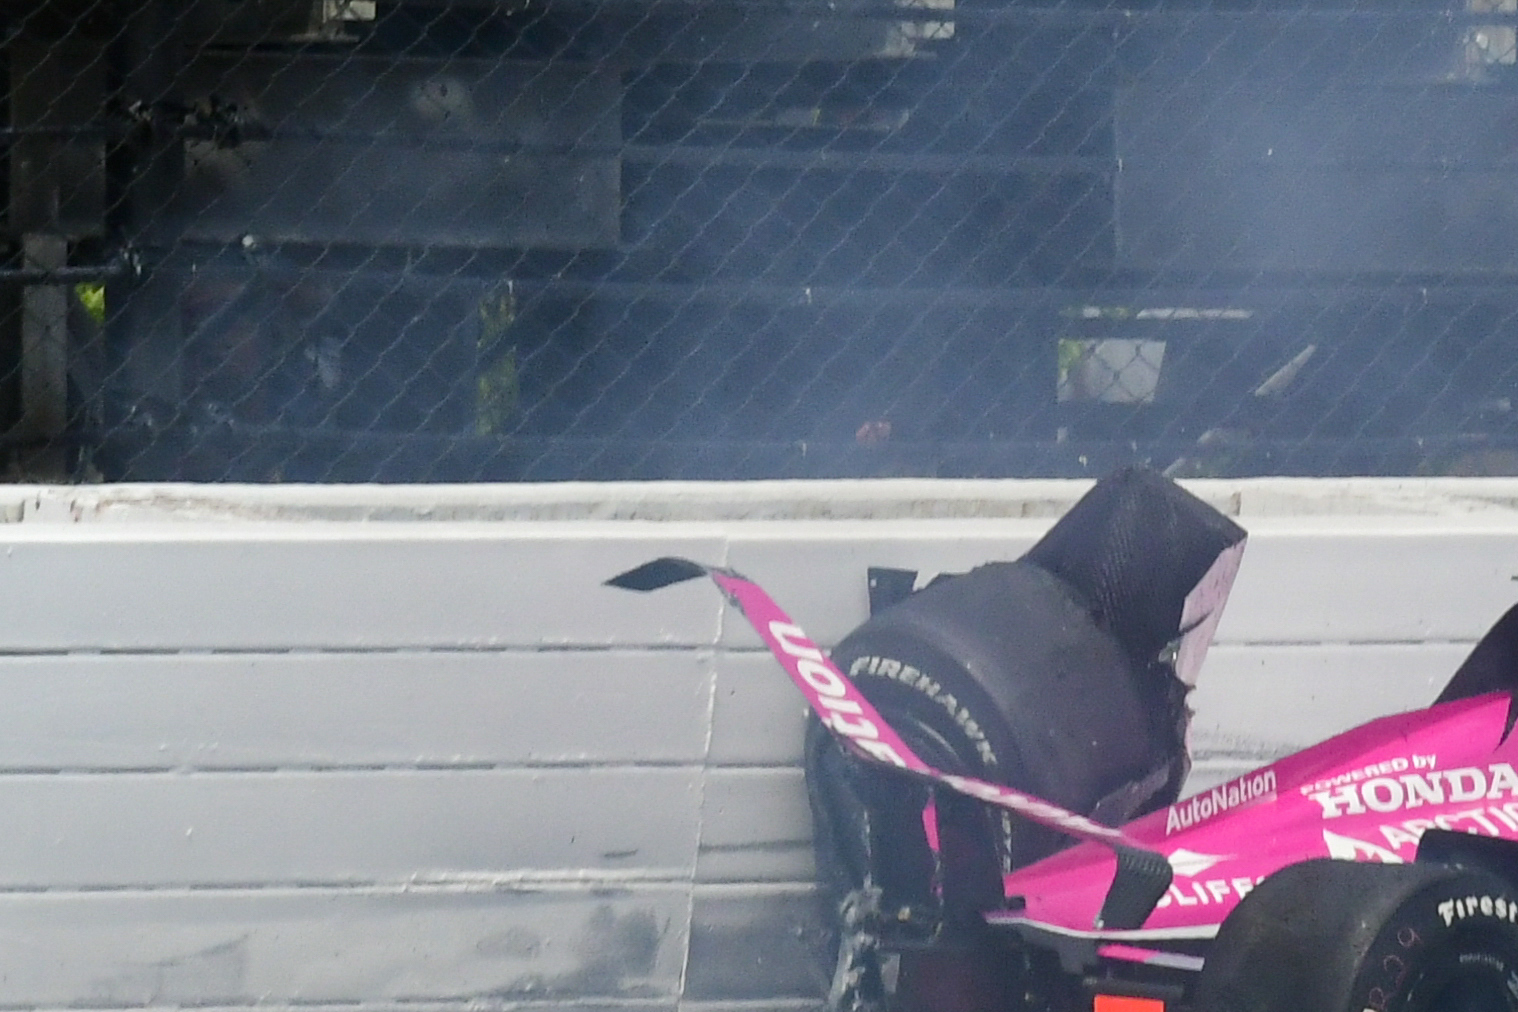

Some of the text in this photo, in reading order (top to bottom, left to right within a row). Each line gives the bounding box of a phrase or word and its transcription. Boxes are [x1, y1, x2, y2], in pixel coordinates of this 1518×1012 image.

[850, 656, 997, 766] FIREHAWK
[1165, 768, 1277, 836] AutoNation
[1300, 754, 1437, 796] POWERED by
[1157, 876, 1266, 908] LIFF
